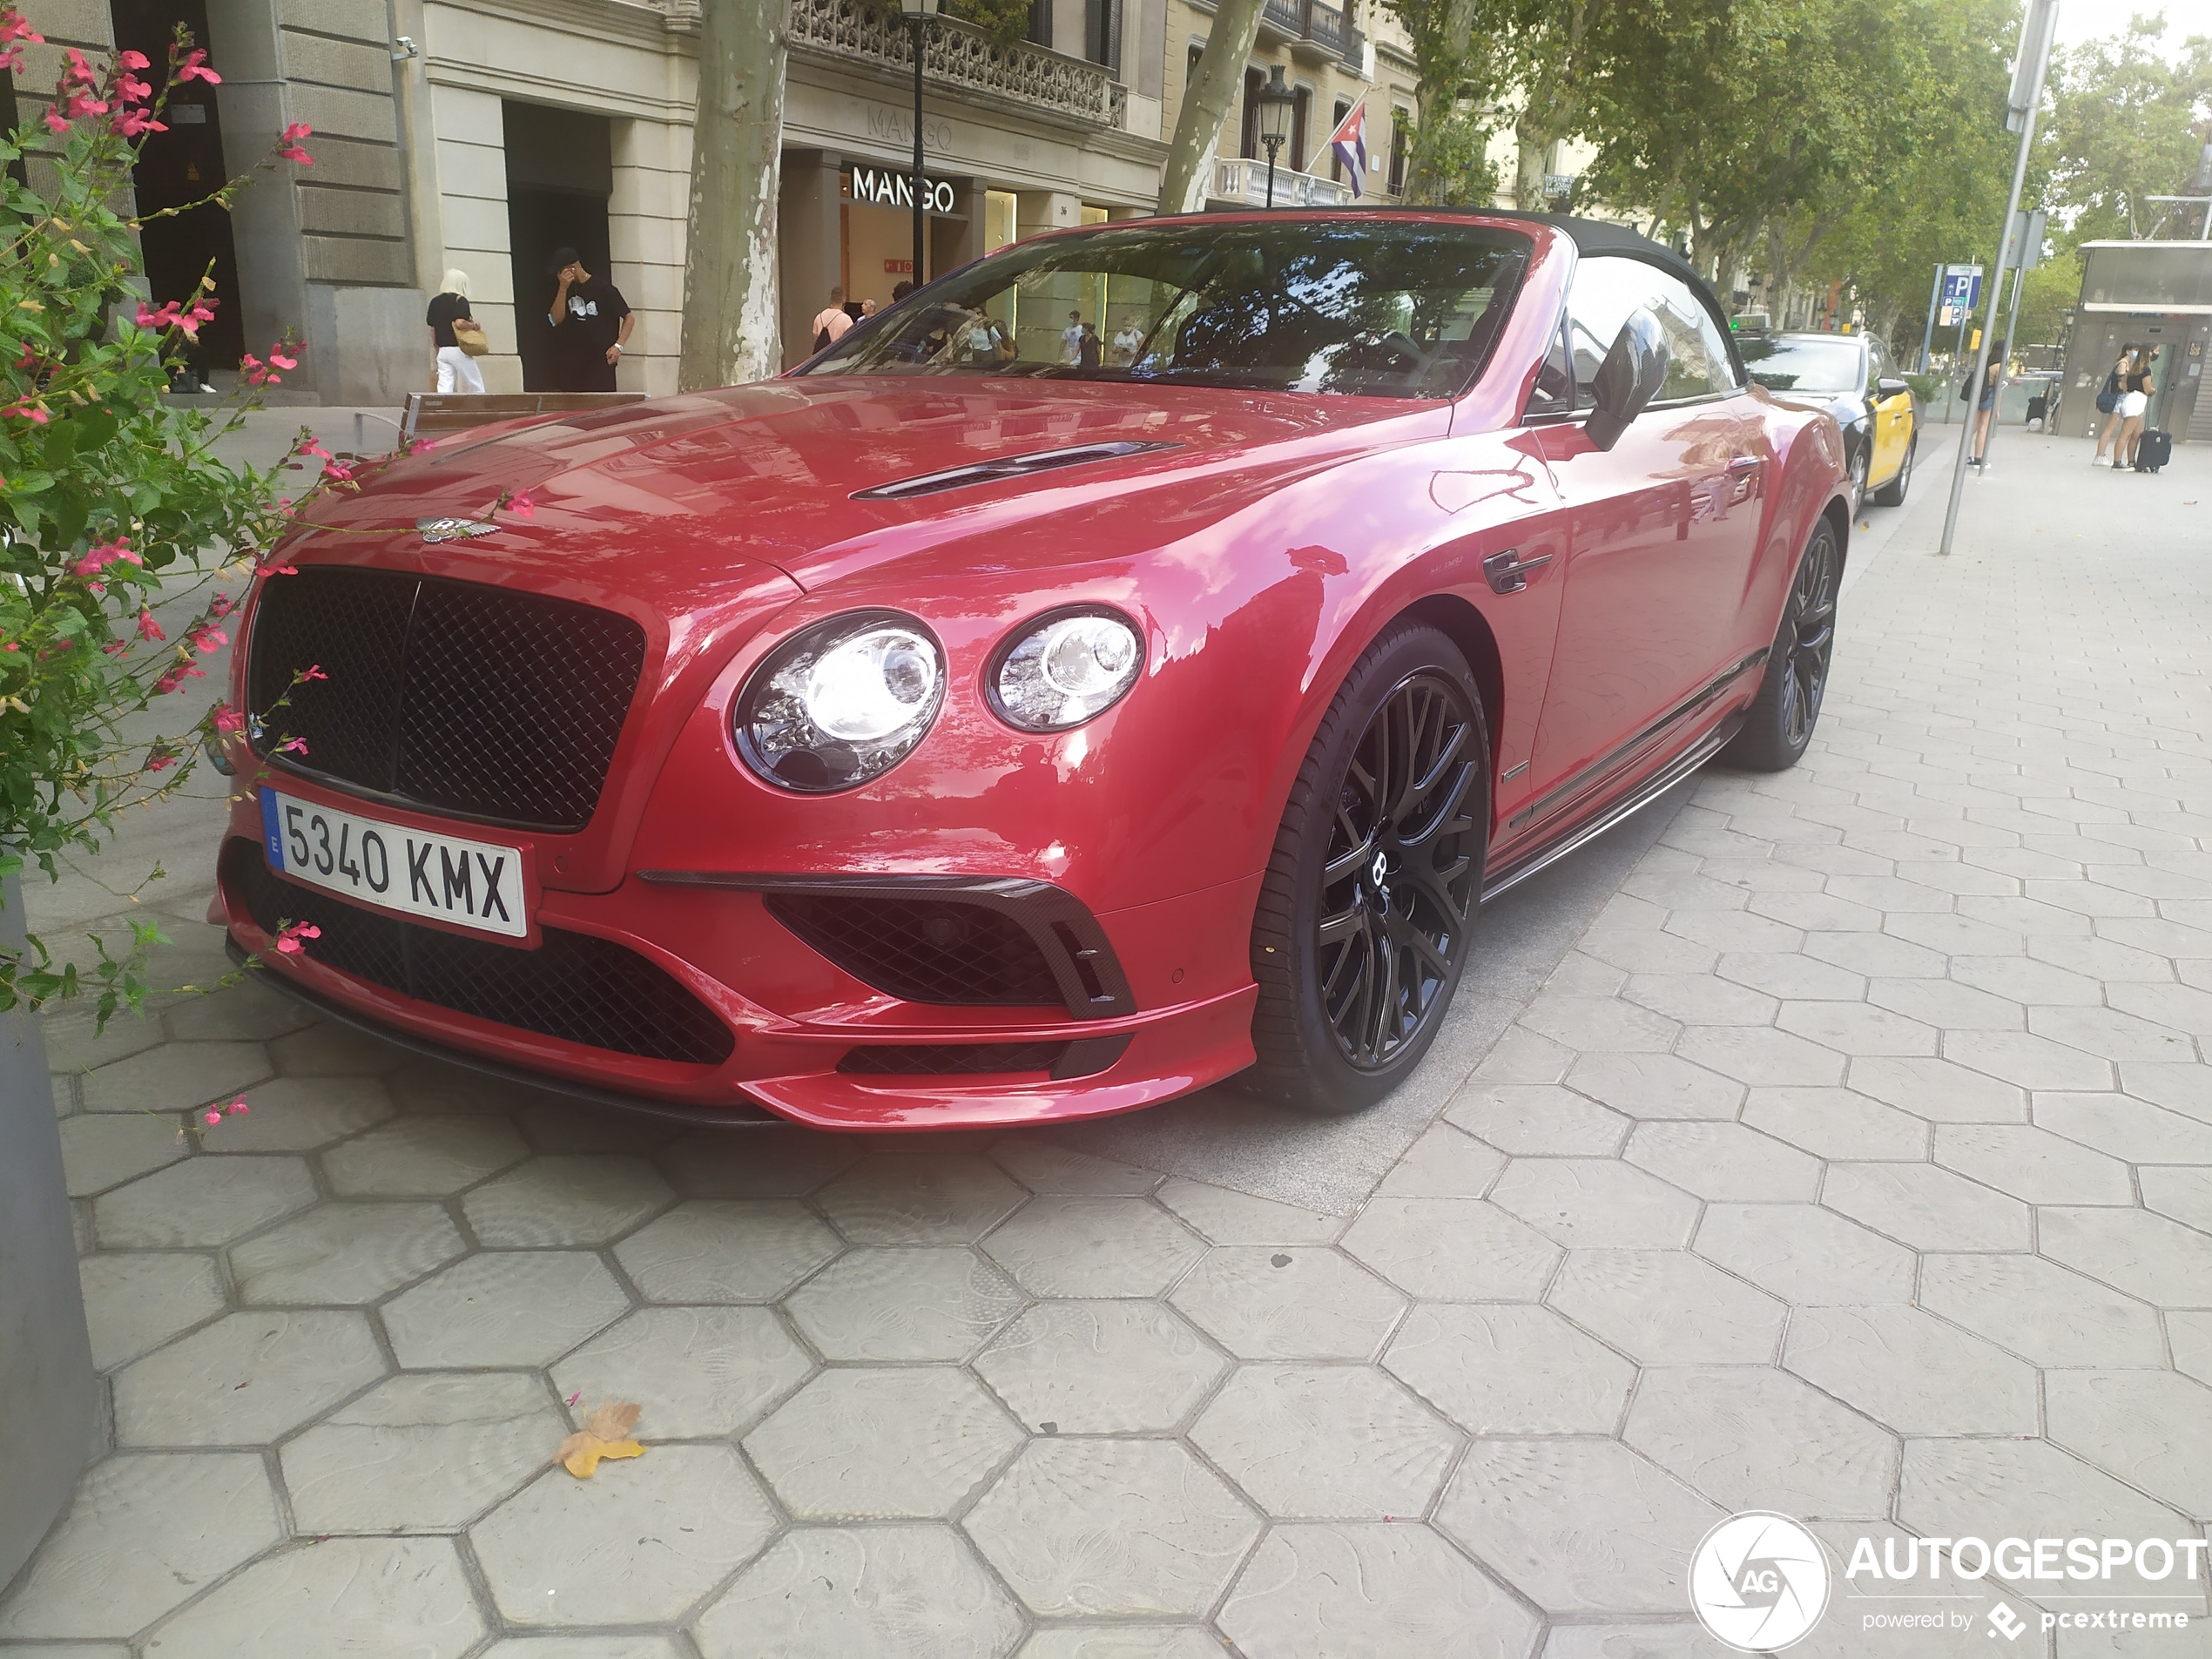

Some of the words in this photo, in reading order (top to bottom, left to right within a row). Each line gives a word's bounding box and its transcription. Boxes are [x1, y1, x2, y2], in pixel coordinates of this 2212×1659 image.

[867, 105, 953, 151] MANGO
[853, 166, 954, 212] MANGO
[1955, 276, 1969, 296] P
[271, 835, 280, 853] E
[285, 804, 390, 894] 5340
[406, 838, 511, 923] KMX
